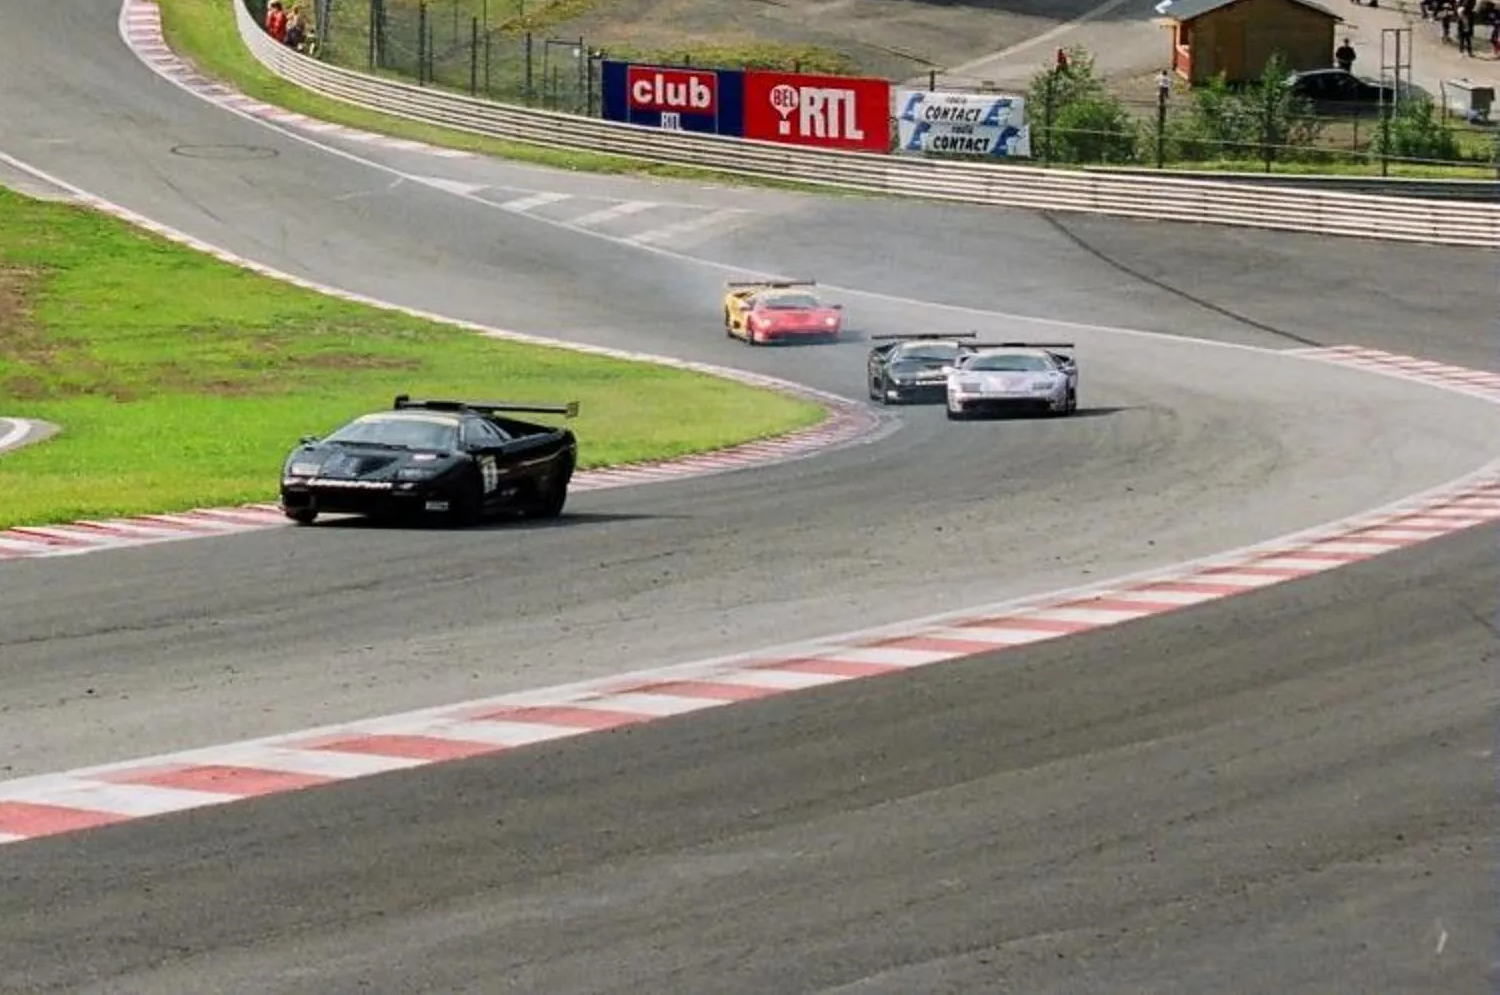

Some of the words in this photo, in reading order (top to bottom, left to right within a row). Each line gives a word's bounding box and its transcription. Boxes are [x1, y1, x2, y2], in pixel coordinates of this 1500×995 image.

[632, 73, 711, 108] club
[773, 88, 795, 107] BEL
[799, 86, 864, 139] RTL
[925, 106, 982, 122] CONTACT
[932, 135, 990, 152] CONTACT
